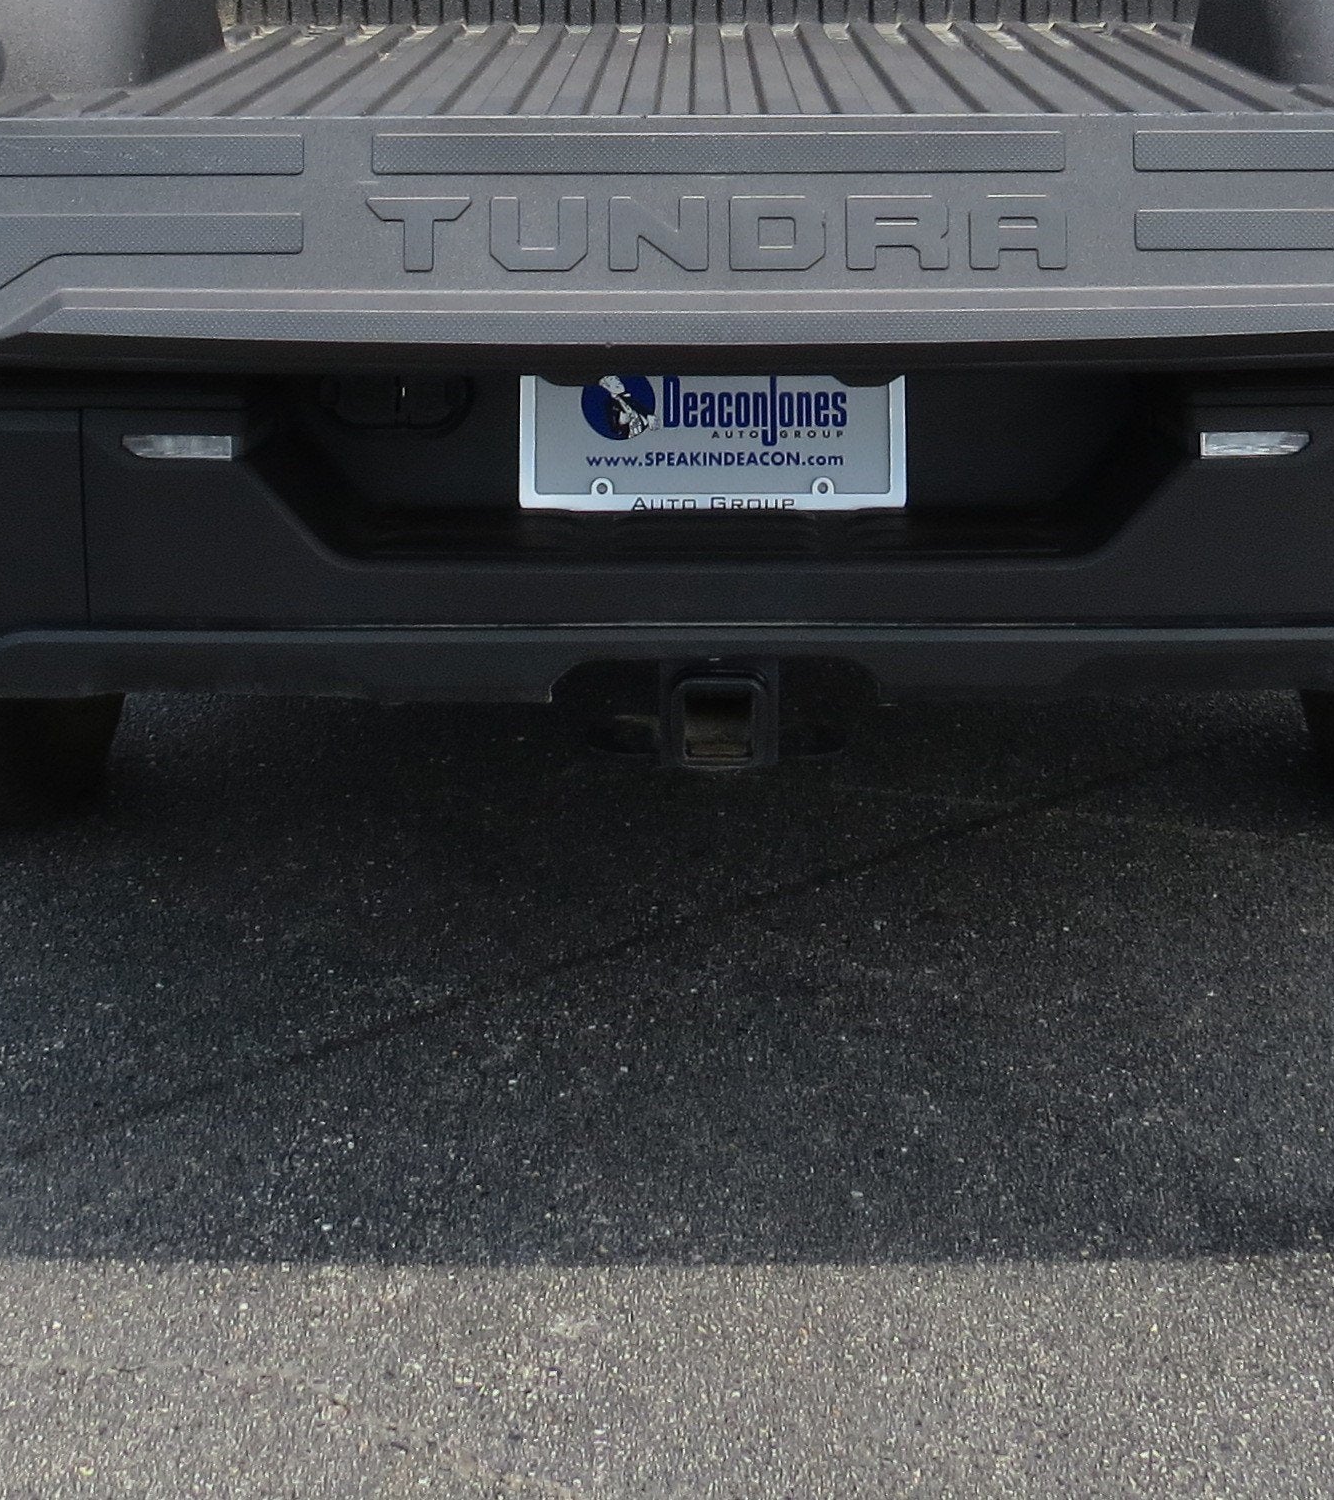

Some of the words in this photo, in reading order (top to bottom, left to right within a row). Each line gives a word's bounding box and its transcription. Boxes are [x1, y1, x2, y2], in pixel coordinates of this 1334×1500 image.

[366, 194, 1067, 272] TUNDRA
[712, 430, 759, 440] AUTO
[780, 430, 845, 440] GROUP
[586, 451, 844, 467] www.SPEAKINDEACON.com
